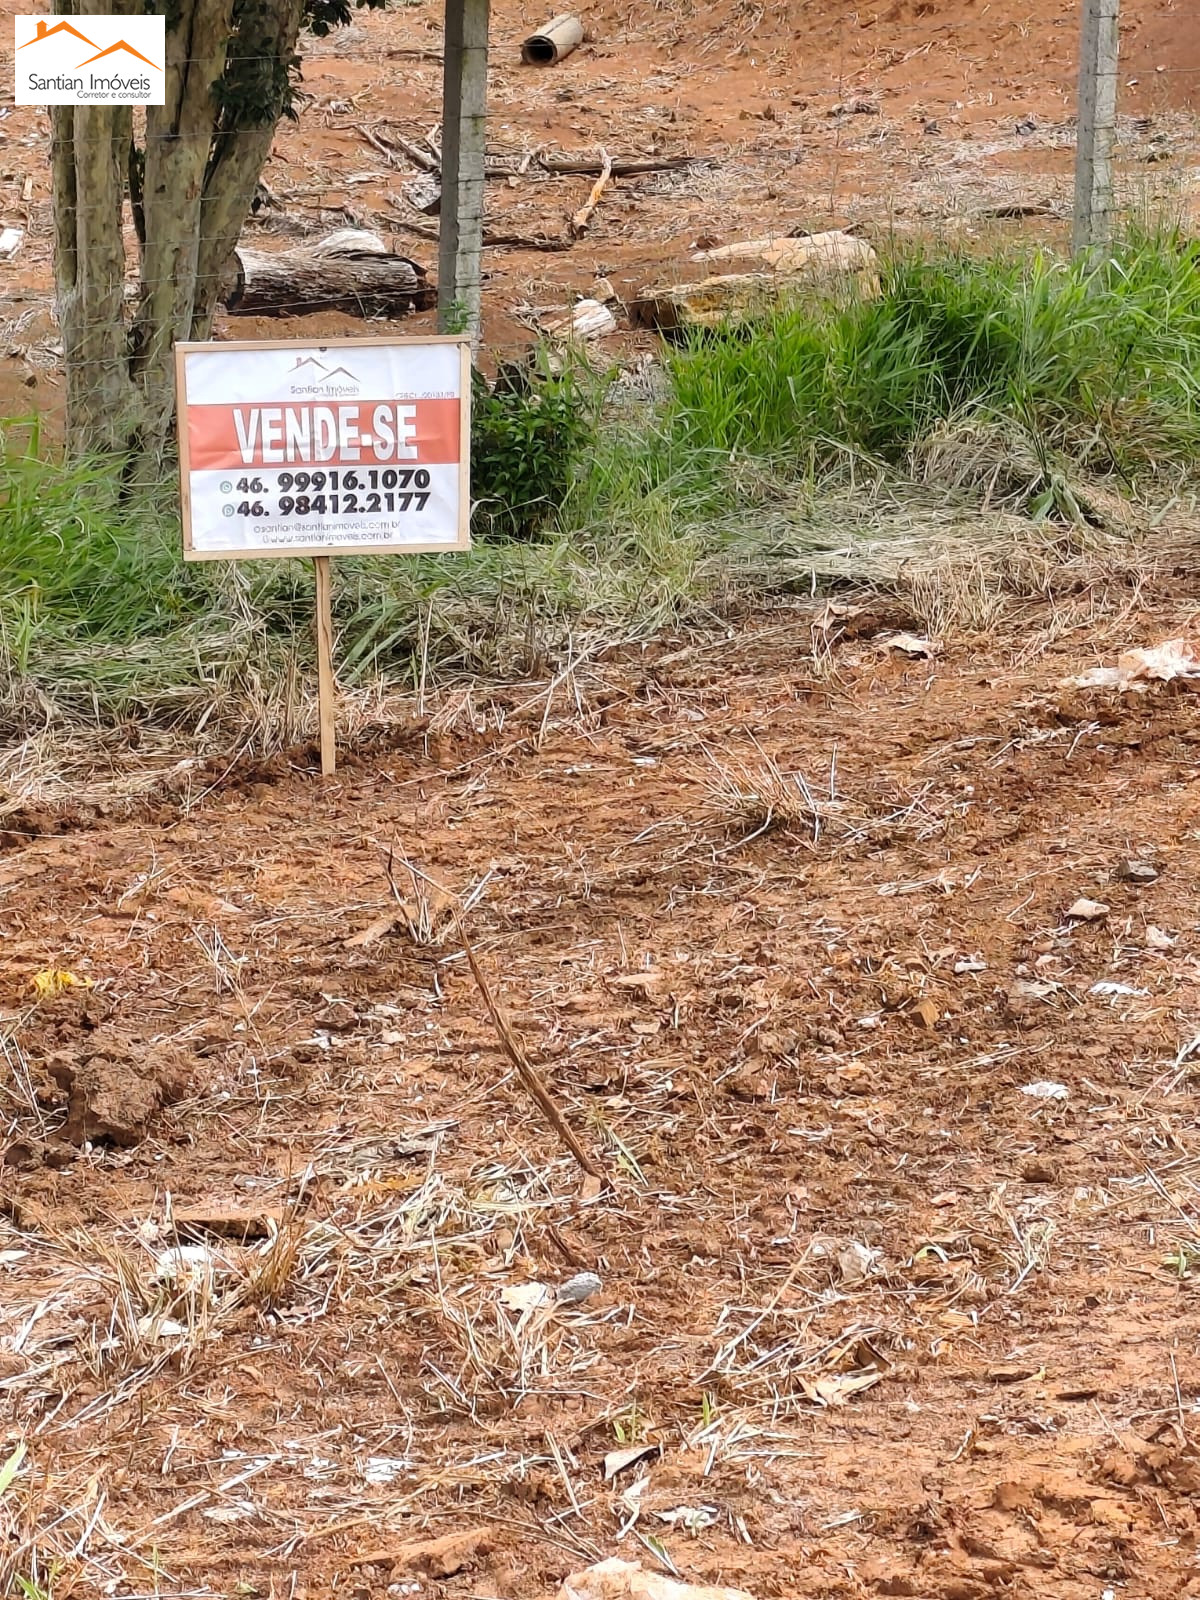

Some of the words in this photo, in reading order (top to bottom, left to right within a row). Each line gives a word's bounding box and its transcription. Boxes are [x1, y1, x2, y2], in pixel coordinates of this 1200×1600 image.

[232, 404, 418, 464] VENDE-SE
[236, 477, 269, 494] 46.
[277, 468, 431, 493] 99916.1070
[236, 500, 270, 517] 46.
[278, 491, 431, 516] 98412.2177
